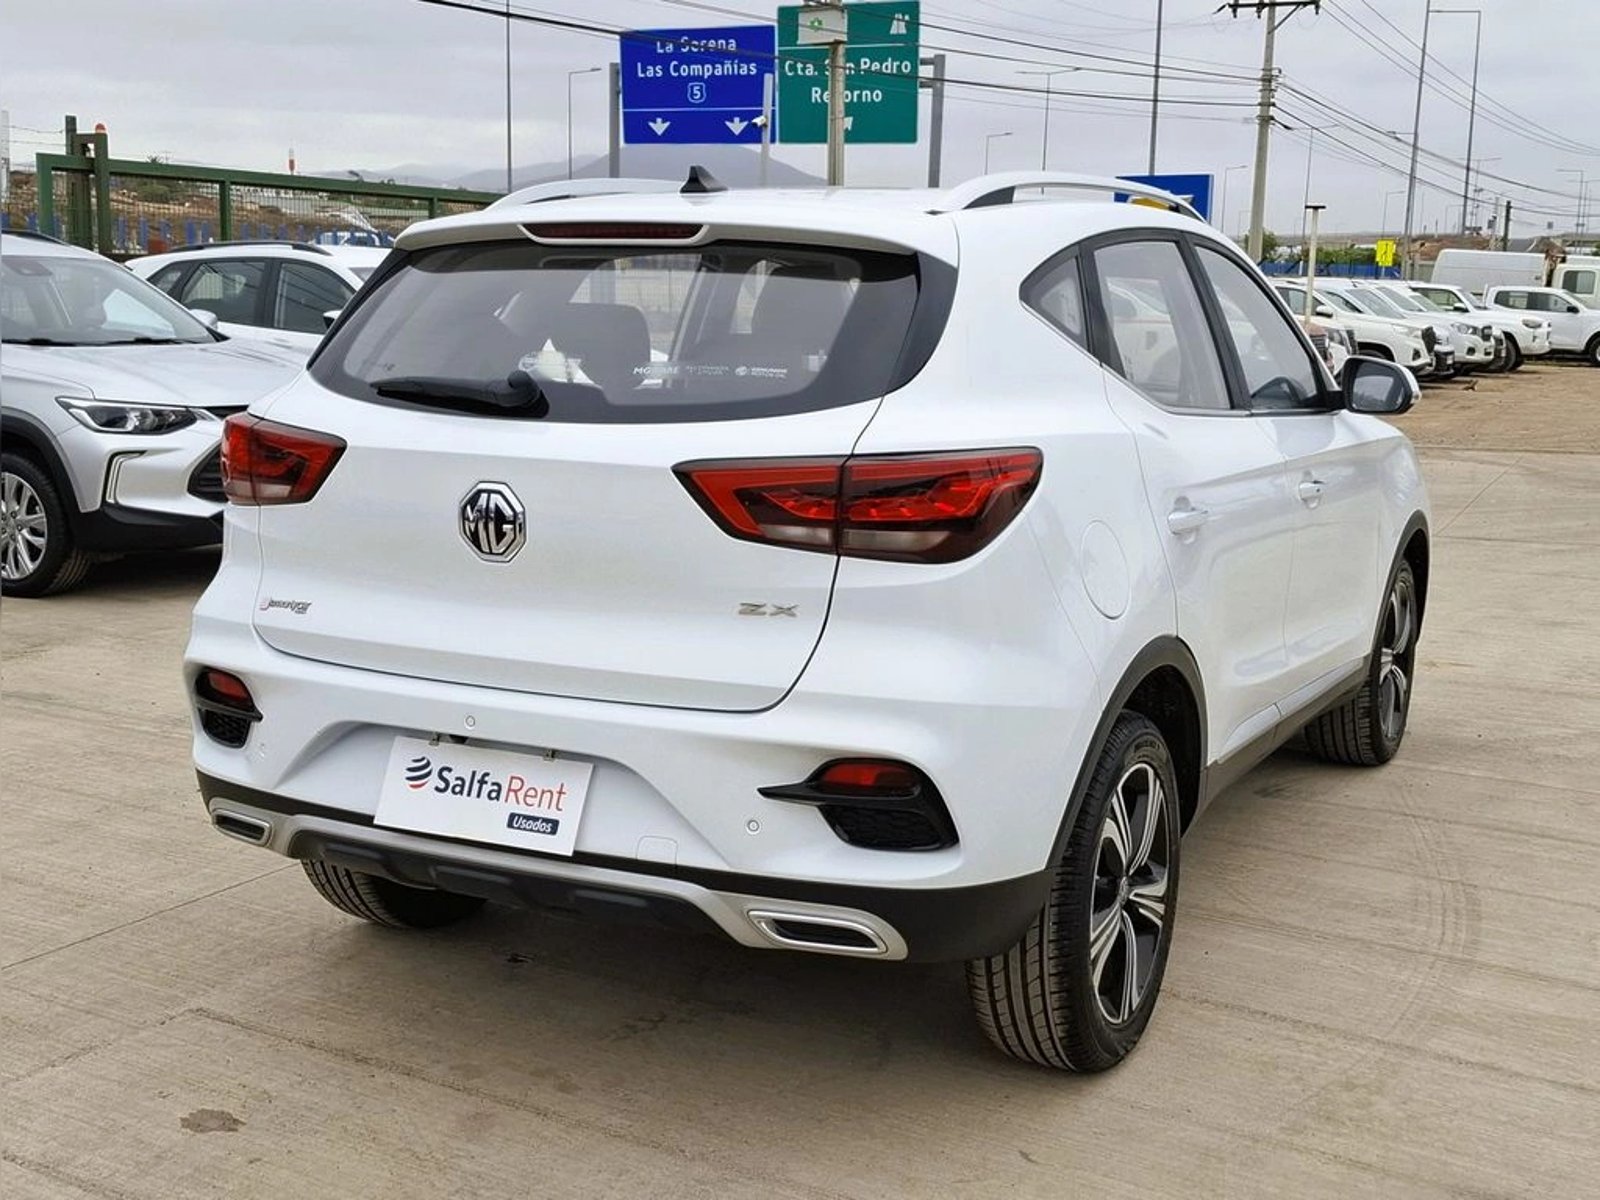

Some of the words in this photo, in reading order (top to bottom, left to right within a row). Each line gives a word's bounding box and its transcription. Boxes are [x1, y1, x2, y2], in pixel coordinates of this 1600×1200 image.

[656, 40, 674, 54] La
[680, 36, 737, 52] Serena
[637, 62, 663, 77] Las
[669, 60, 757, 79] Compañías
[784, 60, 819, 76] Cta.
[824, 58, 856, 75] Sn
[860, 57, 912, 75] Pedro
[692, 86, 701, 99] 5
[811, 86, 883, 103] Reorno
[463, 492, 517, 555] MG
[512, 815, 552, 833] Usados
